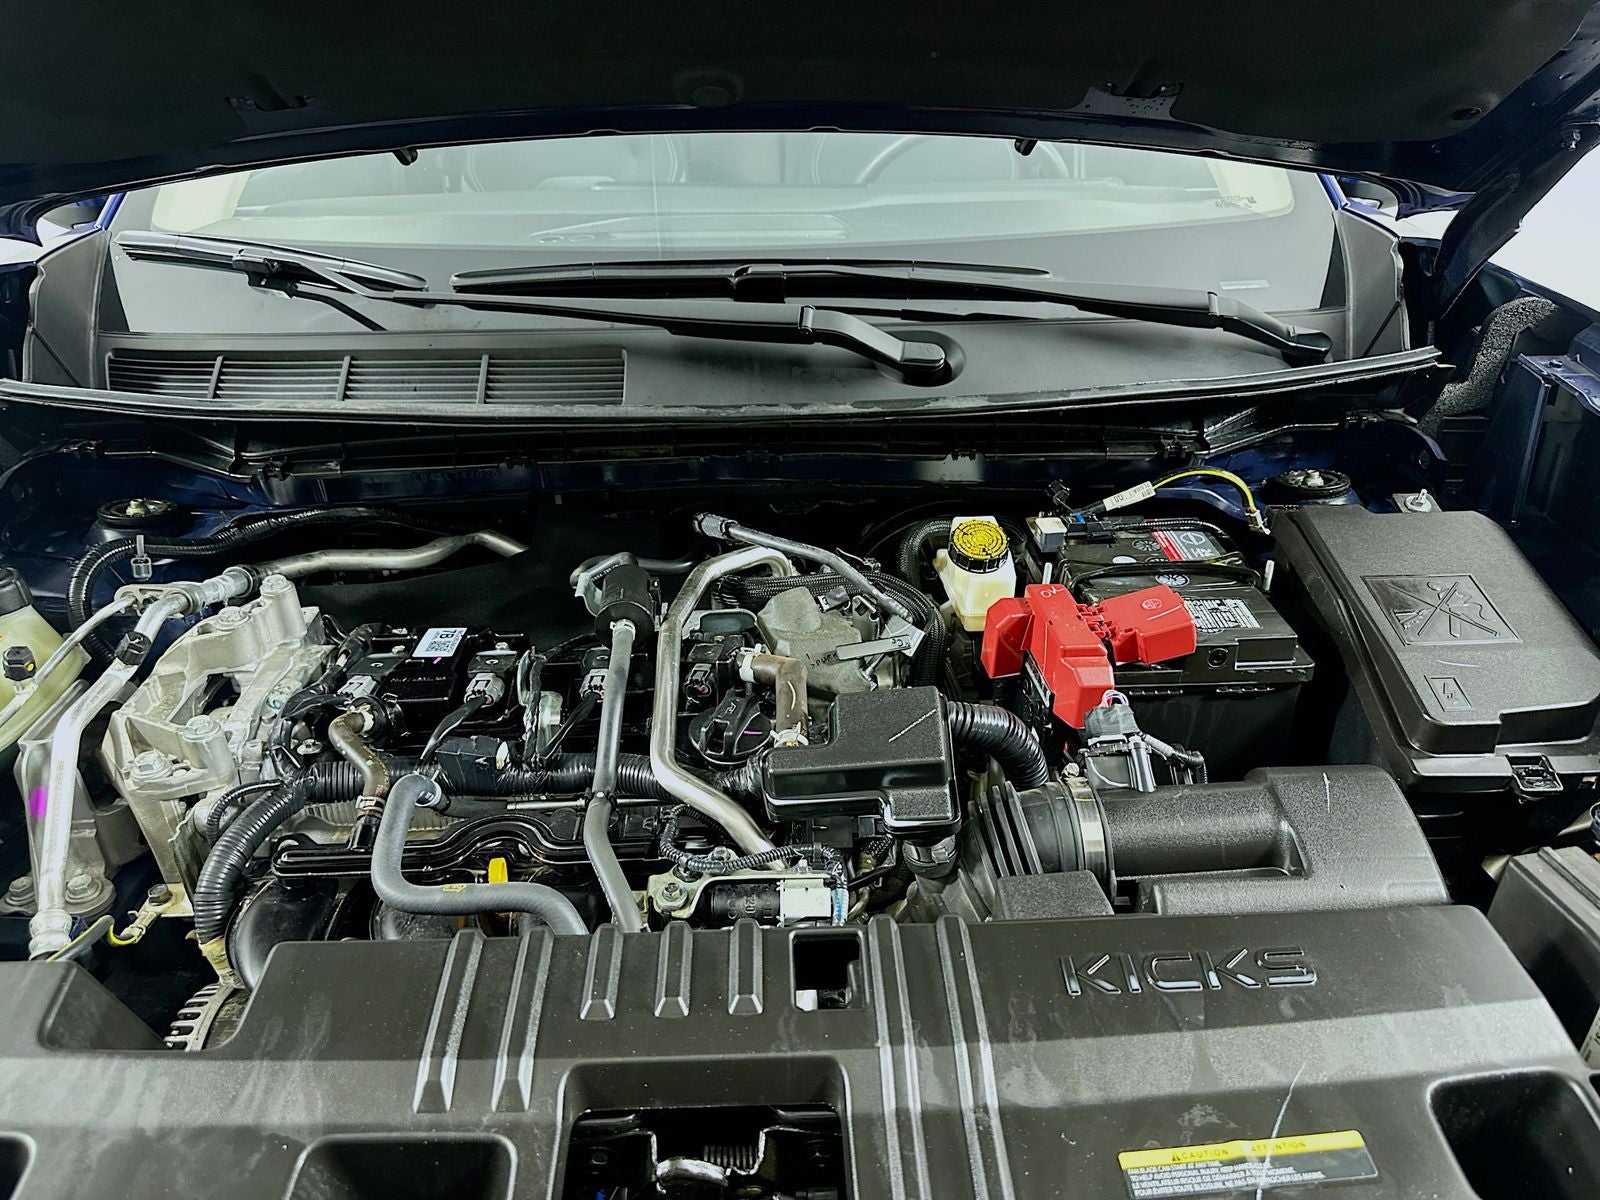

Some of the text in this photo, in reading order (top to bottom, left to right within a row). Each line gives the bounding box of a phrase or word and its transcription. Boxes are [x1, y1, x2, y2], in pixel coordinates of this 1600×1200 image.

[1059, 946, 1318, 995] KICKS
[1181, 1142, 1305, 1159] CAUTION ATTNTION
